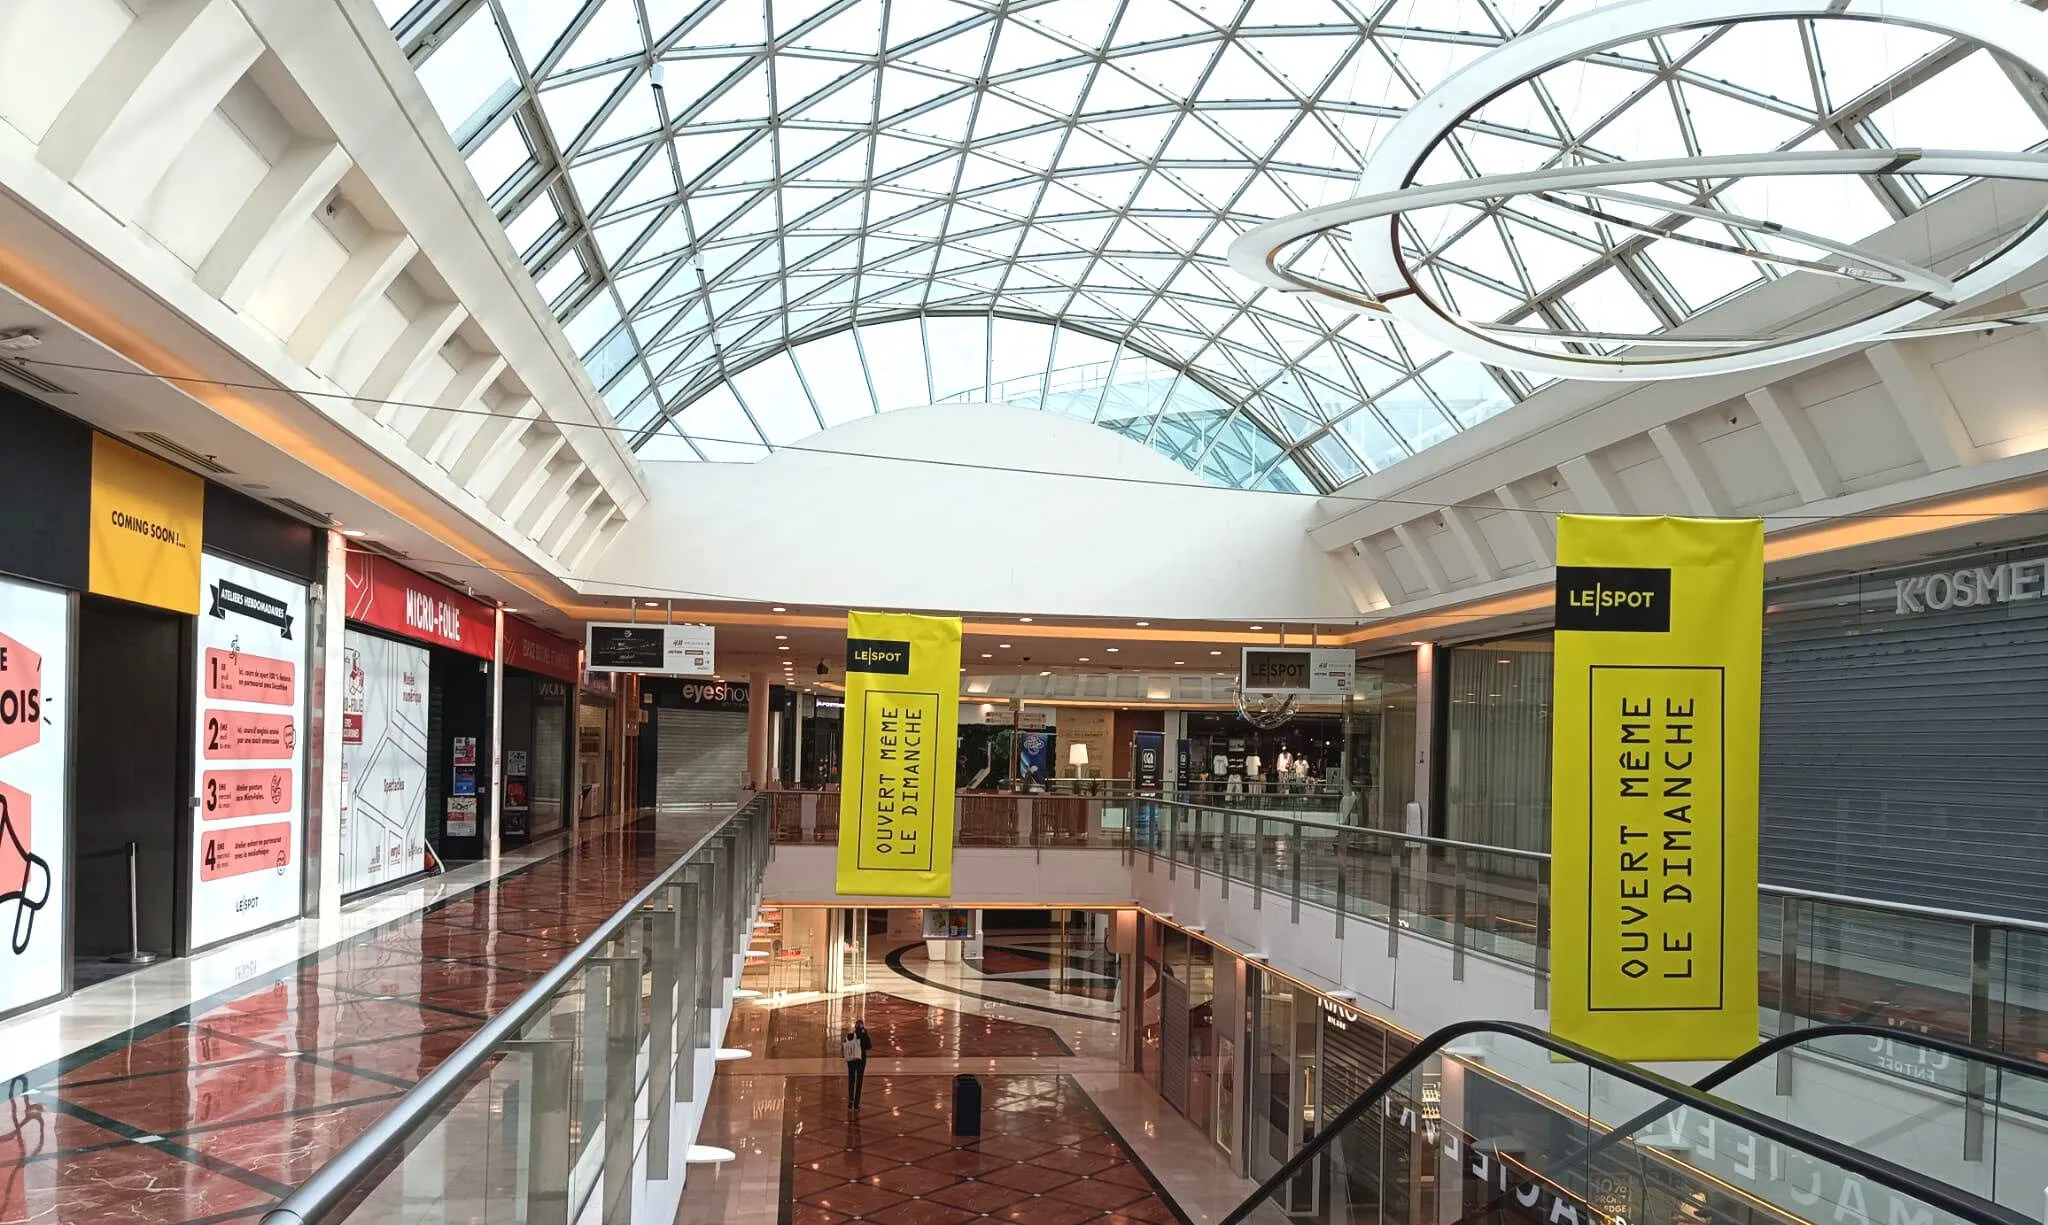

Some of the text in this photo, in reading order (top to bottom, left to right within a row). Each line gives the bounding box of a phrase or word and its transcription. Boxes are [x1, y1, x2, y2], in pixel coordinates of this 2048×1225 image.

[111, 510, 149, 536] COMING
[150, 523, 175, 546] SOON
[221, 588, 244, 605] ATELIERS
[1895, 557, 2048, 615] K'OSME
[406, 587, 461, 641] MICRO-FOLIE
[211, 657, 218, 689] 1
[208, 717, 219, 750] 2
[207, 778, 217, 812] 3
[876, 707, 898, 854] OUVERT MÊME
[900, 708, 922, 854] LE DIMANCHE
[204, 839, 216, 871] 4
[1618, 697, 1651, 979] OUVERT MÊME
[1664, 697, 1694, 979] LE DIMANCHE
